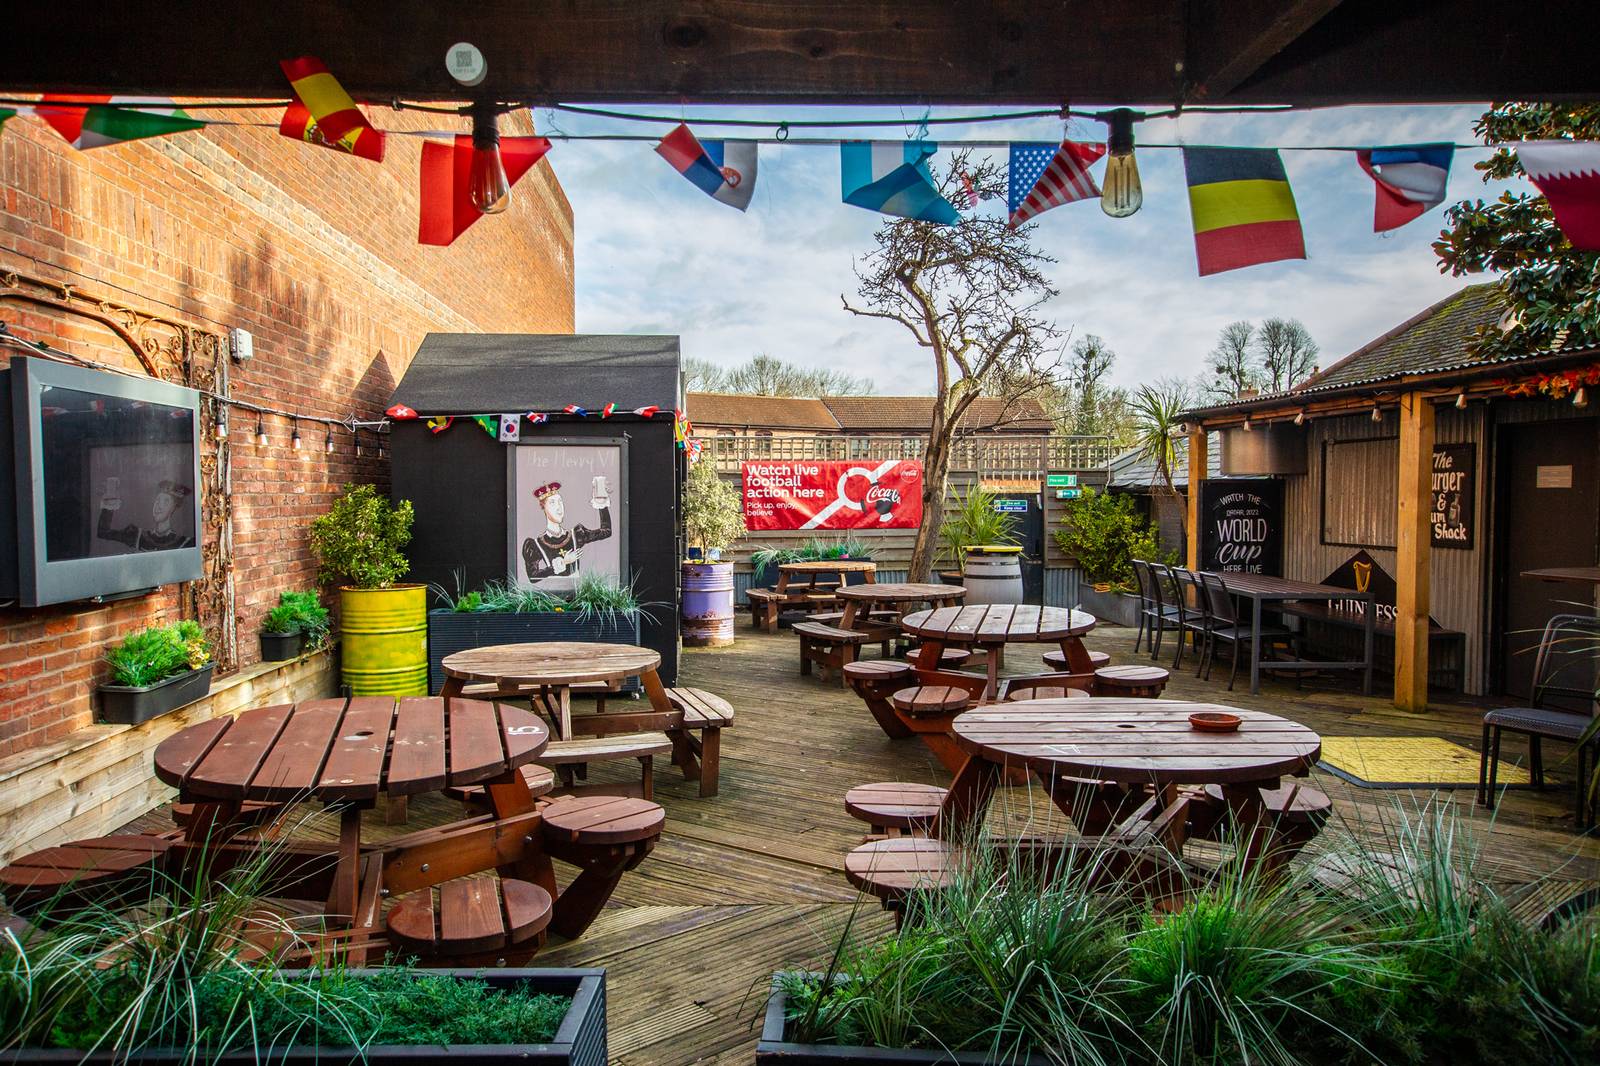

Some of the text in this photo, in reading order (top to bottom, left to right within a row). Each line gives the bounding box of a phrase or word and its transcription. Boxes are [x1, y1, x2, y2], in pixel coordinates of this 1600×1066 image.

[1432, 451, 1453, 469] The
[746, 464, 819, 476] Watch live
[746, 475, 802, 487] football
[1431, 472, 1465, 493] urger
[746, 486, 825, 498] action here
[1219, 493, 1262, 506] WATCH THE
[1437, 493, 1447, 511] &
[1430, 512, 1446, 523] um
[1217, 518, 1267, 543] WORLD
[1215, 542, 1262, 565] Cup
[1223, 564, 1263, 574] HERE LIVE
[1327, 599, 1398, 620] GUINESS
